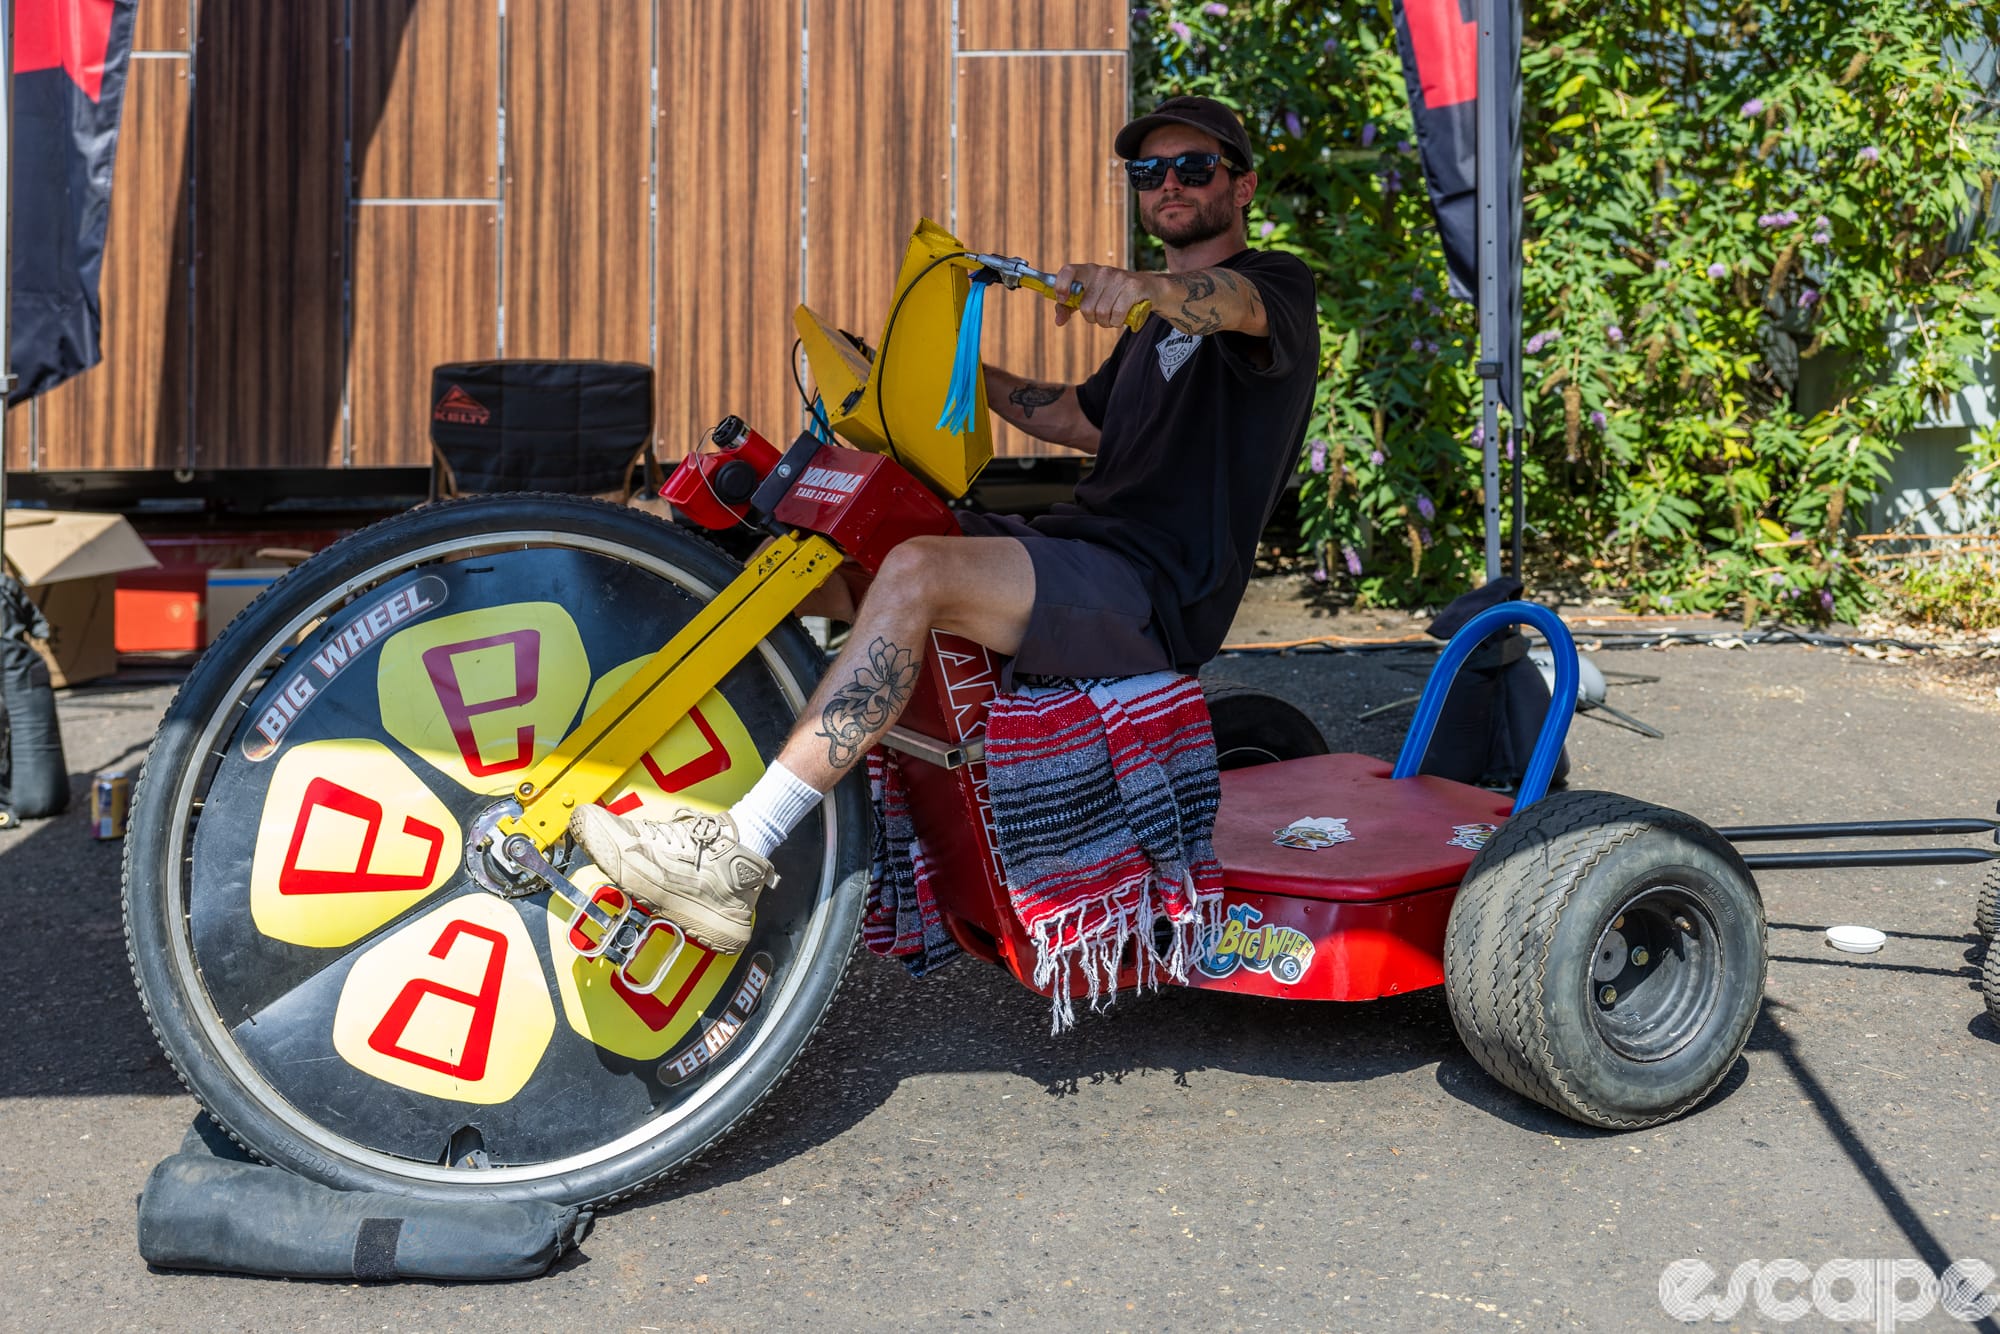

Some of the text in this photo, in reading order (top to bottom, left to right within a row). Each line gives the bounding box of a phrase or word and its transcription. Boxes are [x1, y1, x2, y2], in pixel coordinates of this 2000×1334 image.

[434, 412, 489, 424] KELTY
[799, 466, 864, 493] YAKIMA
[795, 487, 845, 504] TAKE IT EASY
[256, 586, 432, 745] BIG WHEEL
[735, 962, 767, 1013] BIG
